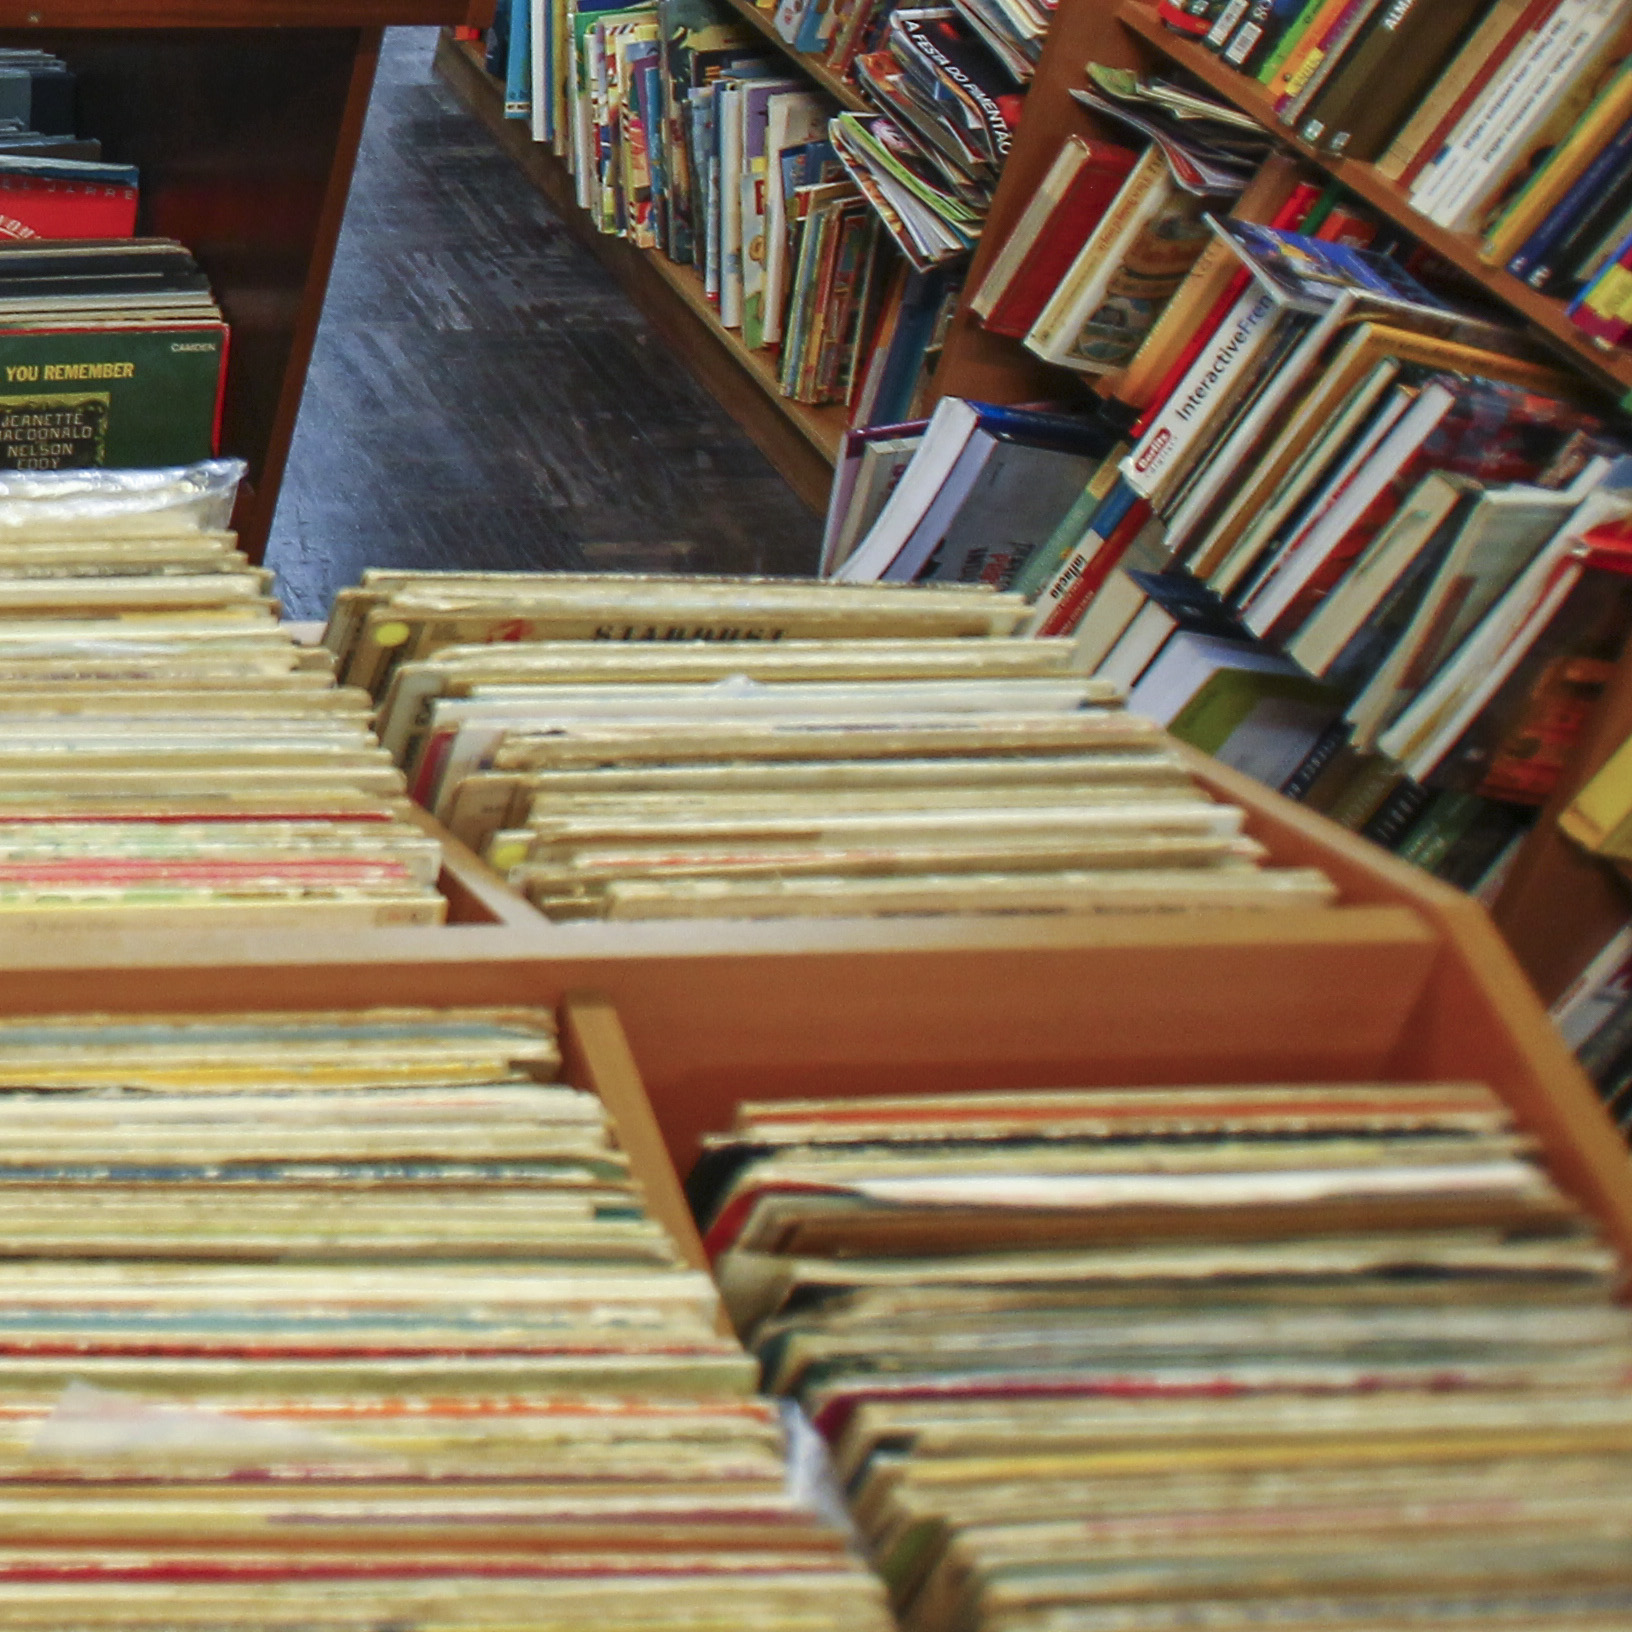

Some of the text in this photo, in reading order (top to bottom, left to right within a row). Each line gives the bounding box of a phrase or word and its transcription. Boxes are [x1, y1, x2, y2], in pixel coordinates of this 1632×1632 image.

[903, 20, 1014, 155] A FESTA DO PIMENTÃO
[171, 343, 216, 352] CAMDEN
[6, 366, 37, 381] YOU
[44, 362, 135, 380] REMEMBER
[1, 414, 84, 428] JEANETTE
[7, 443, 74, 457] NELSON
[1137, 428, 1171, 471] Berlitz
[1050, 554, 1086, 599] inflação
